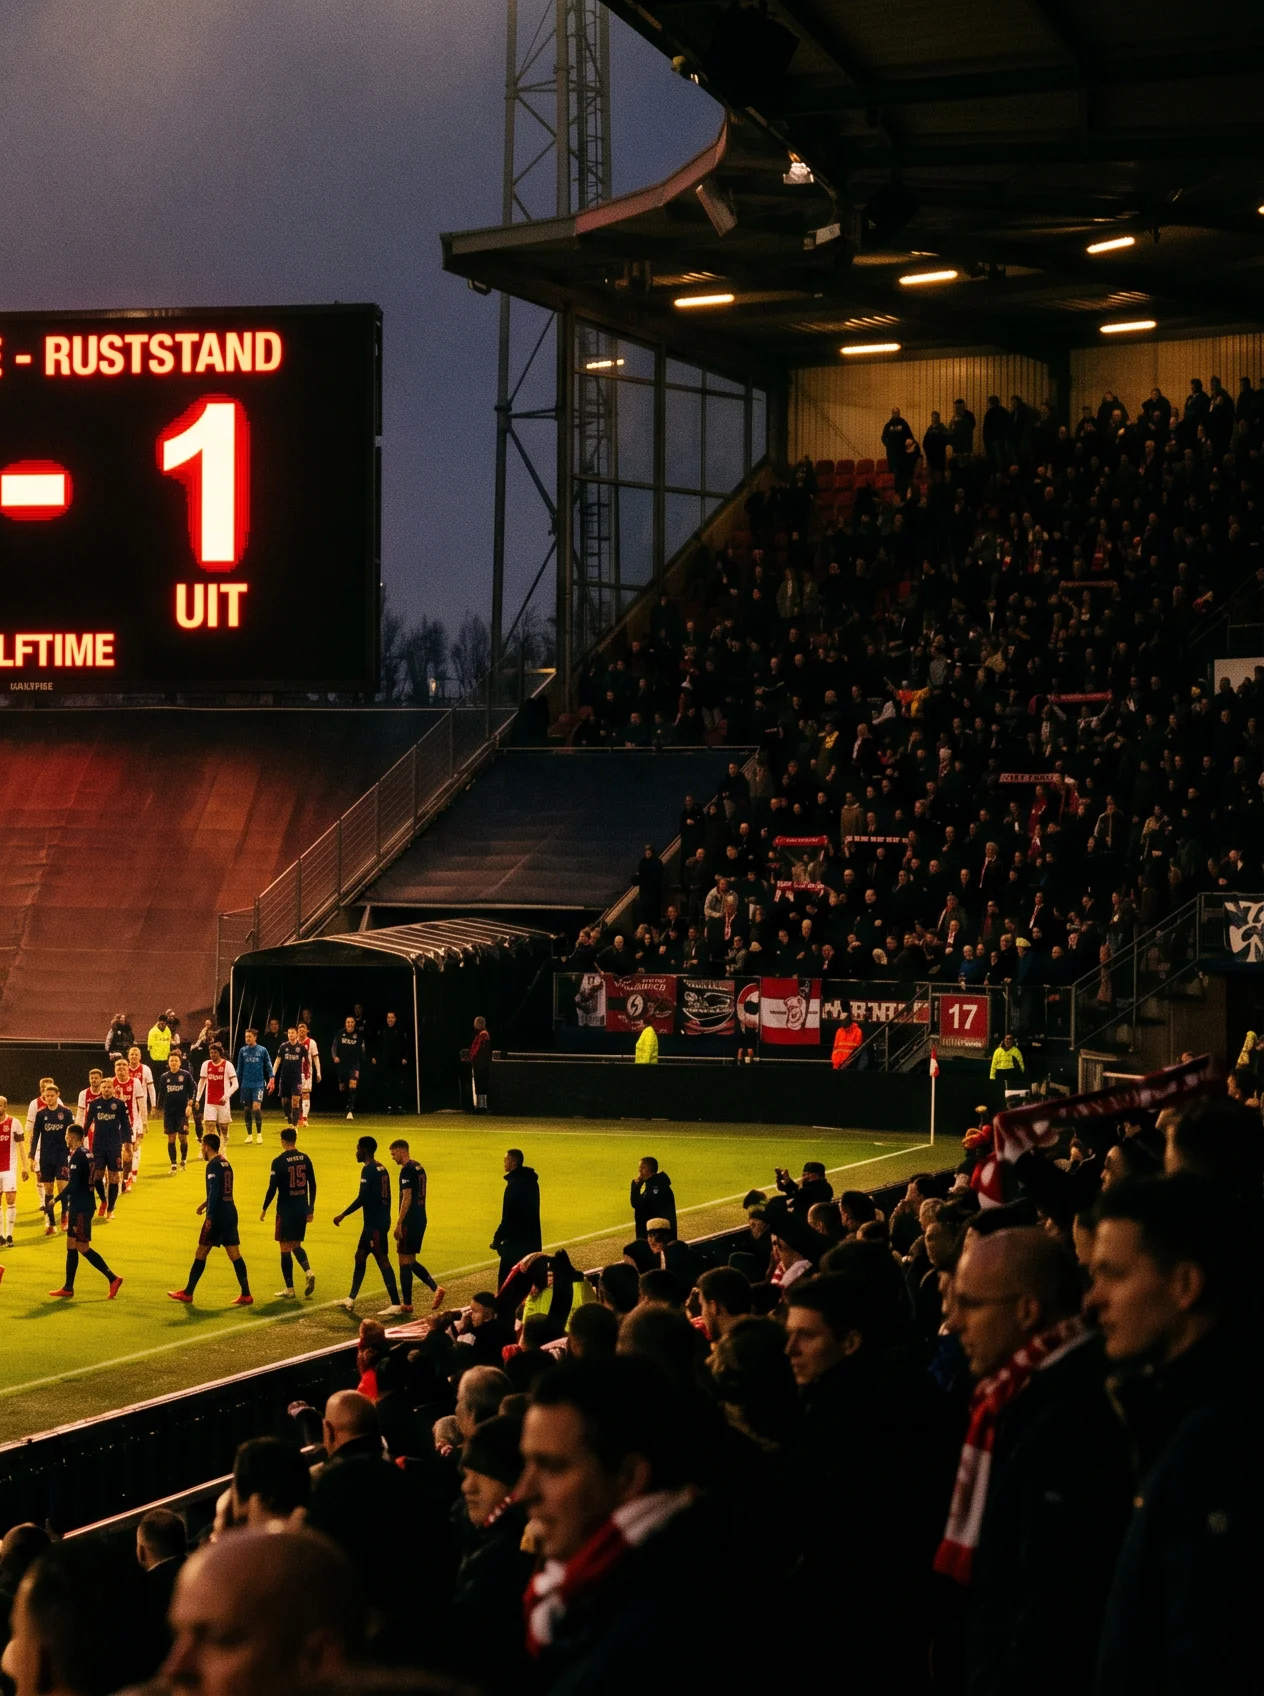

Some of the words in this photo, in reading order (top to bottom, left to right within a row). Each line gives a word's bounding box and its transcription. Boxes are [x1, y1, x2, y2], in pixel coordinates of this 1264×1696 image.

[44, 331, 283, 376] RUSTSTAND
[0, 472, 66, 508] -
[162, 401, 236, 563] 1
[175, 583, 248, 629] UIT
[948, 1003, 978, 1030] 17
[287, 1164, 307, 1188] 15
